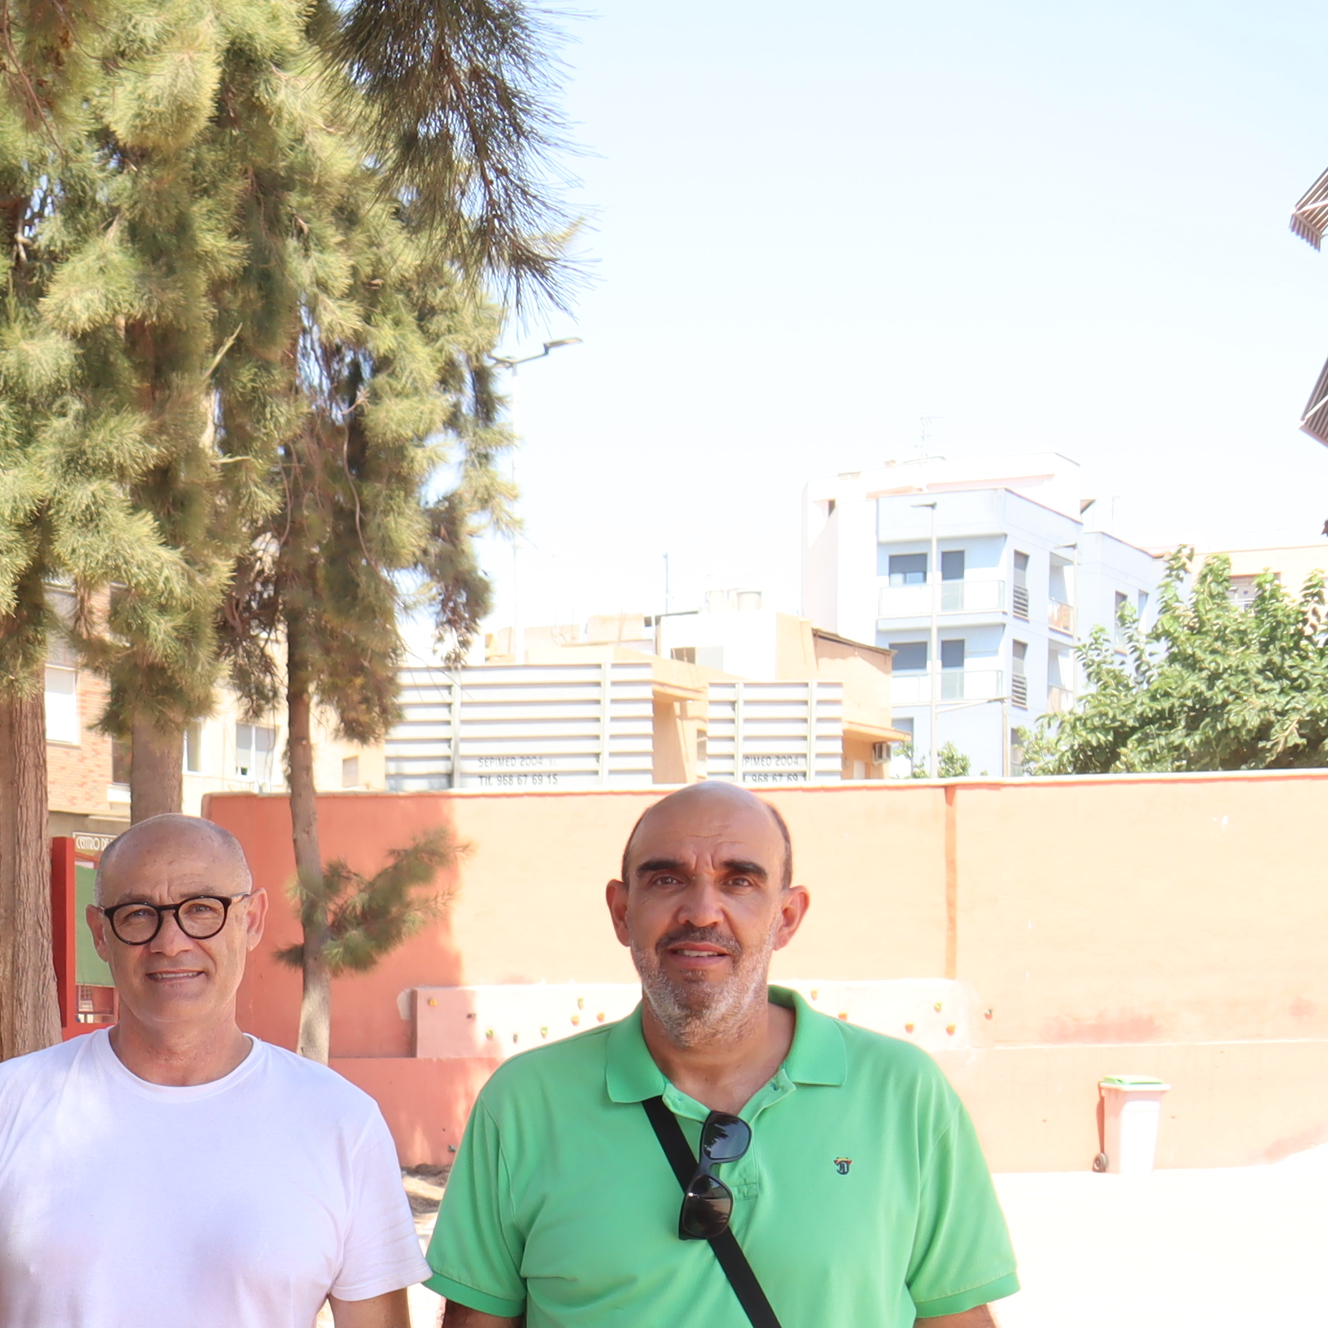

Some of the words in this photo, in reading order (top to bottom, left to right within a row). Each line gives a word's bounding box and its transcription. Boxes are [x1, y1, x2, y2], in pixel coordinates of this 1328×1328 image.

[519, 755, 544, 767] 2004
[742, 755, 772, 767] PIMED
[497, 774, 514, 786] 968
[517, 774, 528, 786] 67
[532, 773, 544, 785] 69
[547, 773, 558, 785] 15
